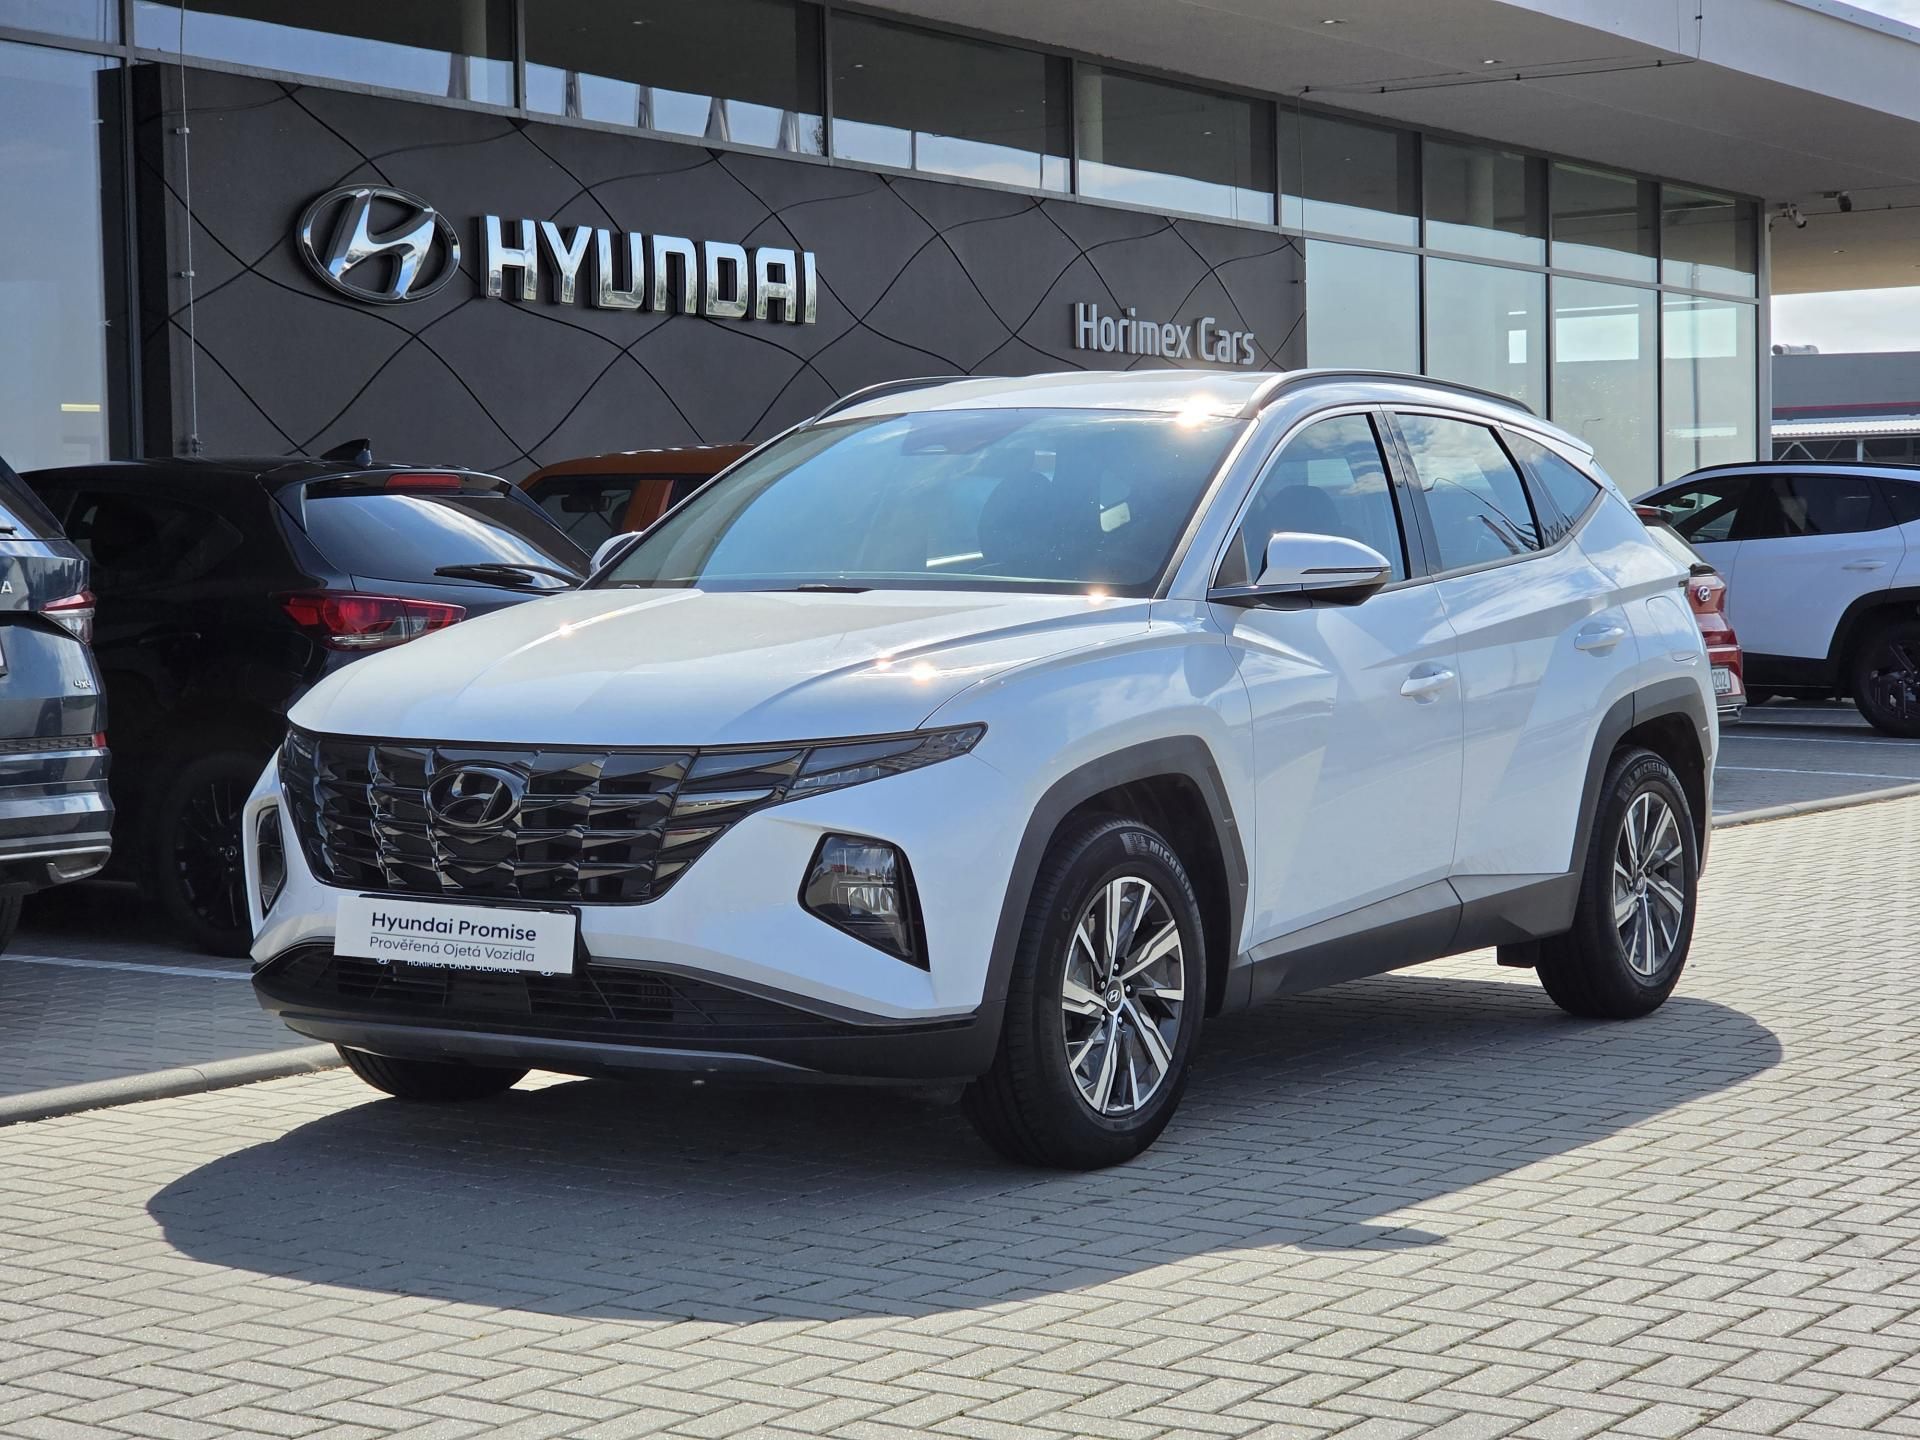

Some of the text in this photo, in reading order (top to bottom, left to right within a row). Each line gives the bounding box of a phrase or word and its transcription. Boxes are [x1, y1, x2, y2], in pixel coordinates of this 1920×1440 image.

[481, 214, 817, 325] HYUNDAI
[1074, 302, 1256, 365] Horimex Cars
[1633, 762, 1669, 779] MICHELIN
[1148, 840, 1195, 902] MICHELIN
[369, 935, 536, 963] Prověřená Ojetá Vozidla
[371, 911, 537, 942] Hyundai Promise
